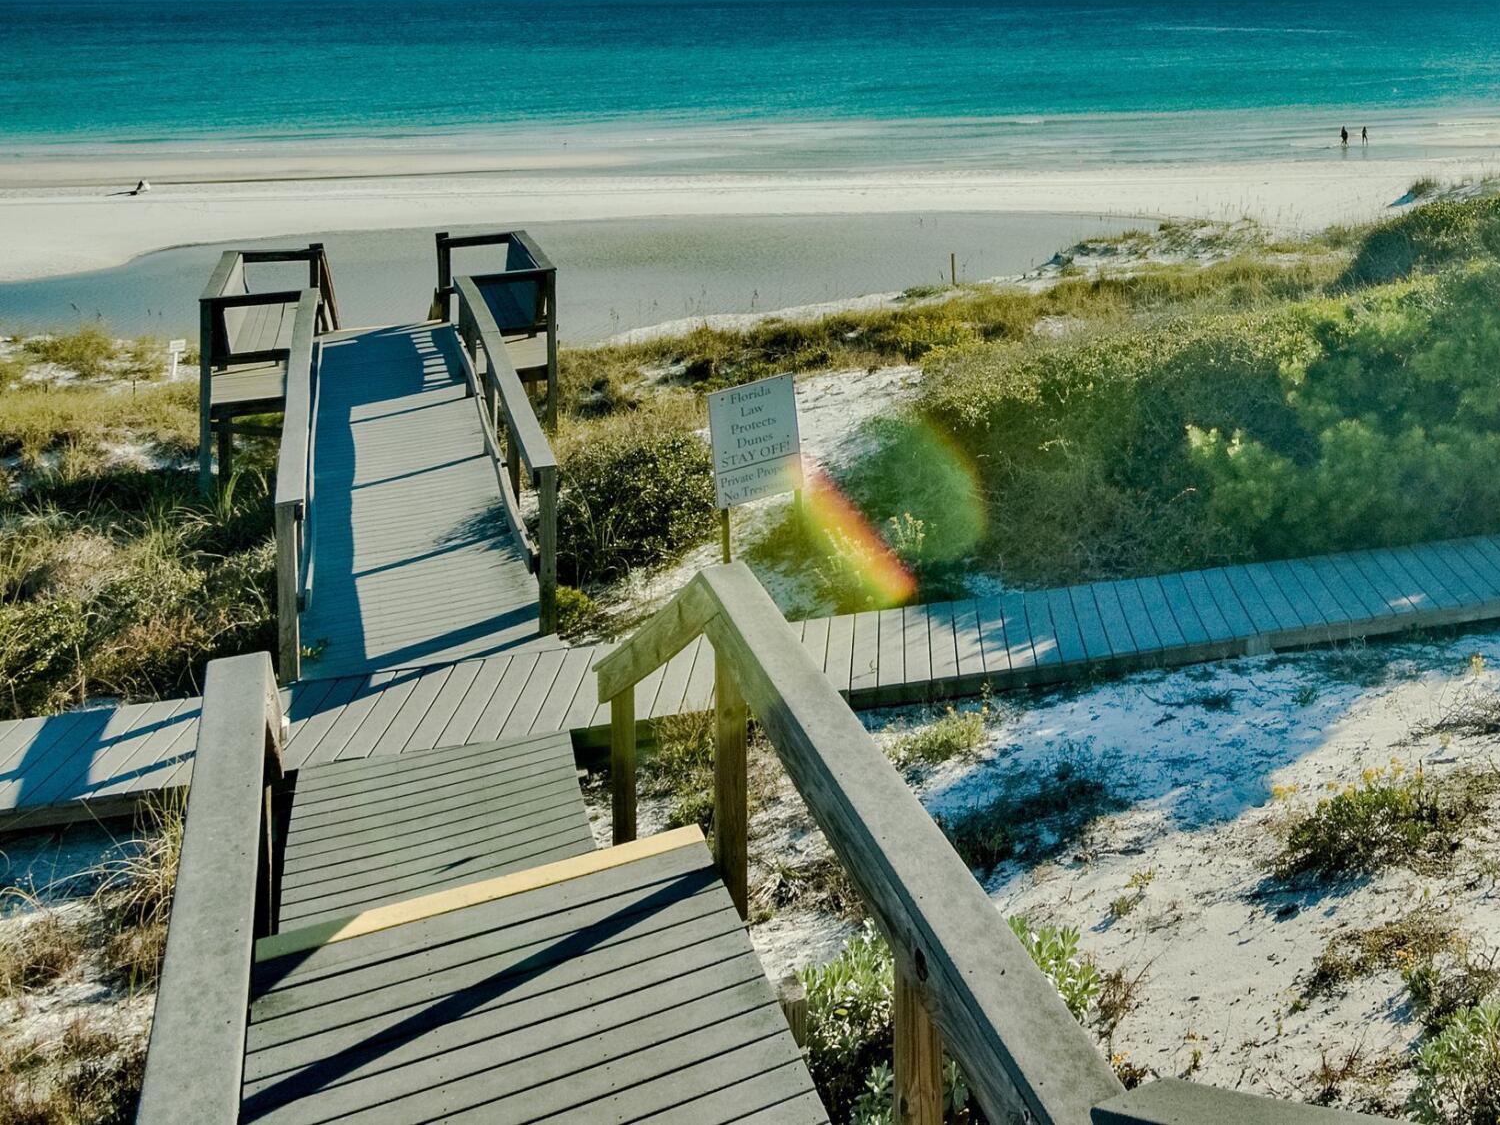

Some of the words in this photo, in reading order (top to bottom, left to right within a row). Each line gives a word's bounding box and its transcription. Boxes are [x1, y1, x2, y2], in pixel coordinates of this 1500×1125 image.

[730, 386, 772, 404] Florida
[740, 403, 764, 417] Law
[731, 416, 777, 435] Protects
[736, 433, 774, 449] Dunes
[721, 449, 757, 468] STAY
[760, 440, 790, 458] OFF!
[720, 473, 754, 489] Private
[724, 490, 740, 503] No
